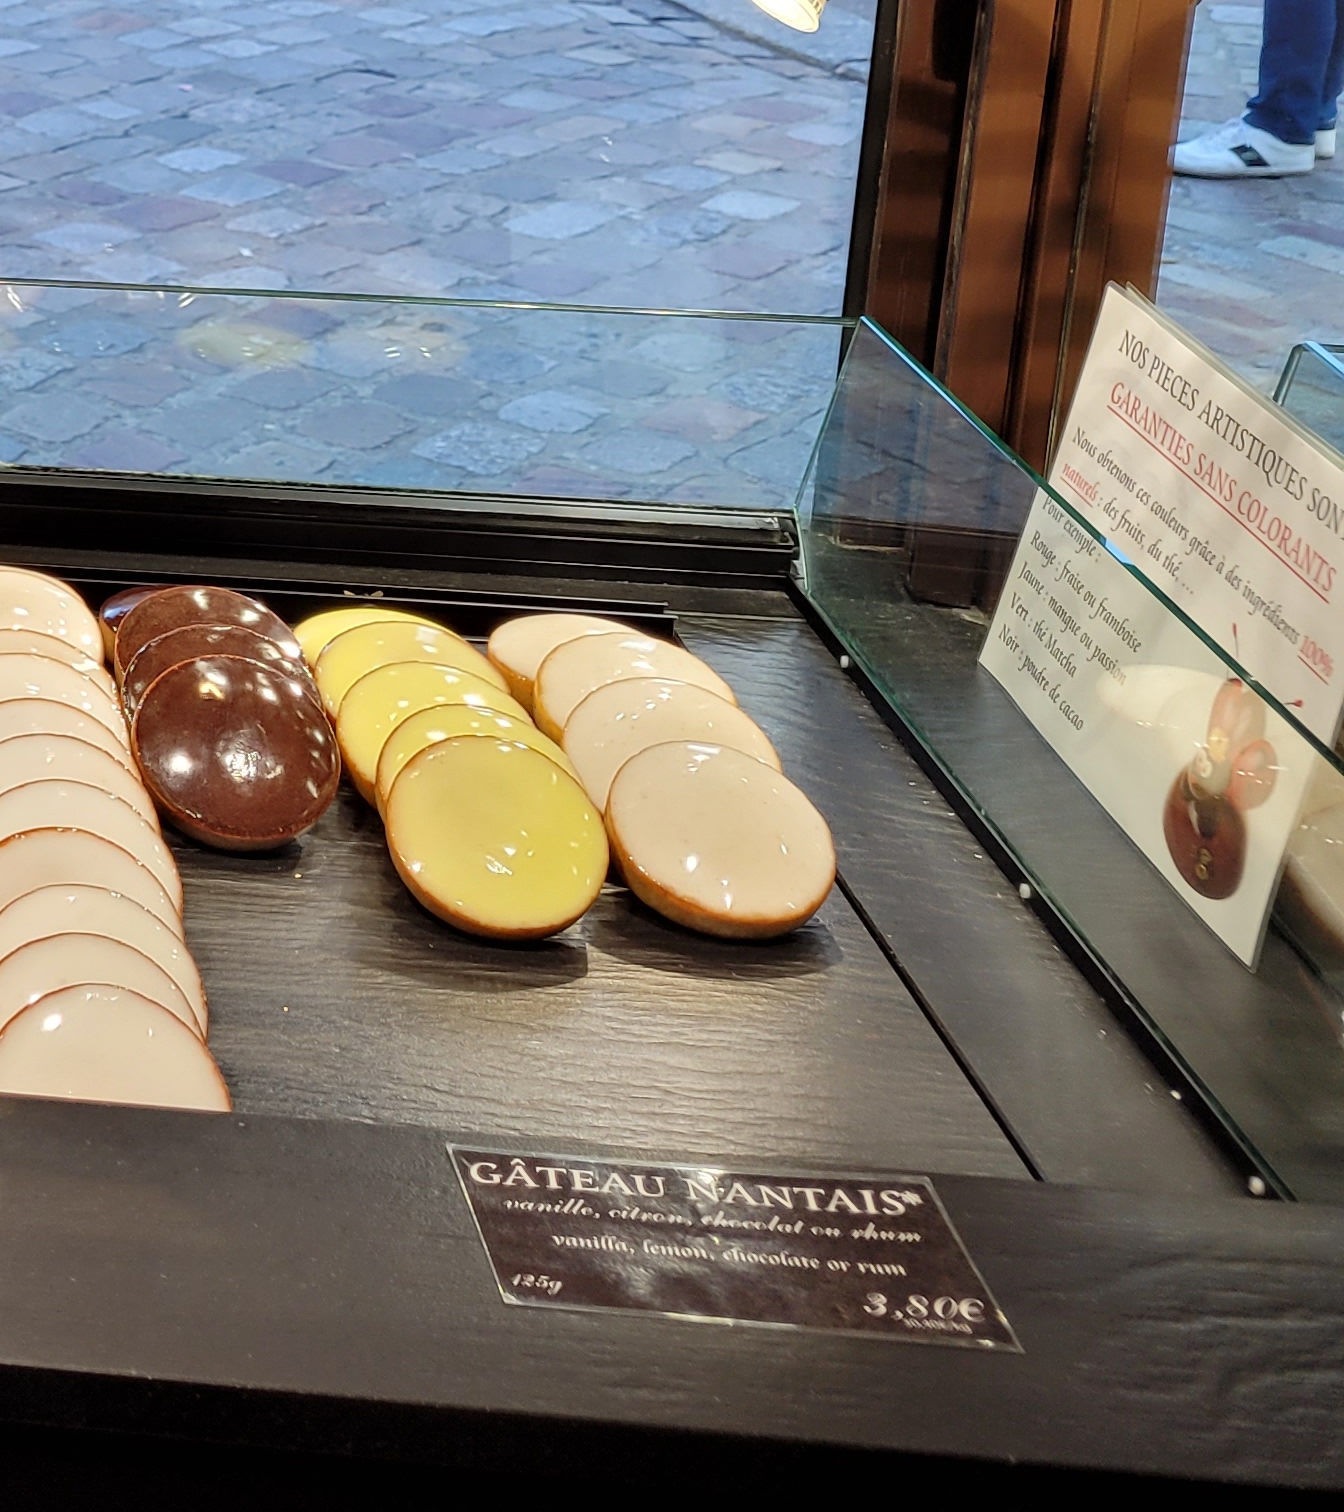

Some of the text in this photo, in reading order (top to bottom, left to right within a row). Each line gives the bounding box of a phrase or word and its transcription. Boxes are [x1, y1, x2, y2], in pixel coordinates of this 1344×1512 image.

[1117, 329, 1344, 540] NOS PIECES ARTISTIQUES SON
[1109, 381, 1337, 592] GARANTIES SANS COLORANTS
[1042, 495, 1065, 525] Pour
[1063, 518, 1097, 556] exemple
[1062, 462, 1100, 502] naturels
[1102, 497, 1118, 521] des
[1112, 510, 1145, 550] fruits,
[1147, 539, 1162, 565] du
[1162, 552, 1183, 584] thé,
[1030, 529, 1058, 568] Rouge
[1072, 426, 1334, 678] Nous obtenons ces couleurs grâce à des ingrédients 100%
[1017, 561, 1045, 595] Jaune
[1054, 559, 1084, 596] fraise
[1083, 590, 1097, 608] ou
[1011, 592, 1030, 622] Vert
[1032, 619, 1047, 642] thé
[1044, 633, 1078, 679] Matcha
[1047, 593, 1081, 637] mangue
[1088, 597, 1143, 653] framboise
[1080, 632, 1093, 650] ou
[998, 623, 1020, 653] Noir
[1018, 651, 1050, 692] poudre
[1048, 683, 1061, 704] de
[1058, 700, 1085, 731] cacao
[1086, 644, 1127, 686] passion
[469, 1158, 908, 1216] GÂTEAU NANTAIS
[503, 1198, 601, 1220] vanille,
[608, 1206, 693, 1226] citron,
[701, 1210, 805, 1234] chocolat
[851, 1222, 922, 1243] rhum
[552, 1235, 907, 1277] vanilla, lemon, chocolate or rum
[511, 1272, 563, 1296] 125g
[863, 1292, 986, 1322] 3,80€
